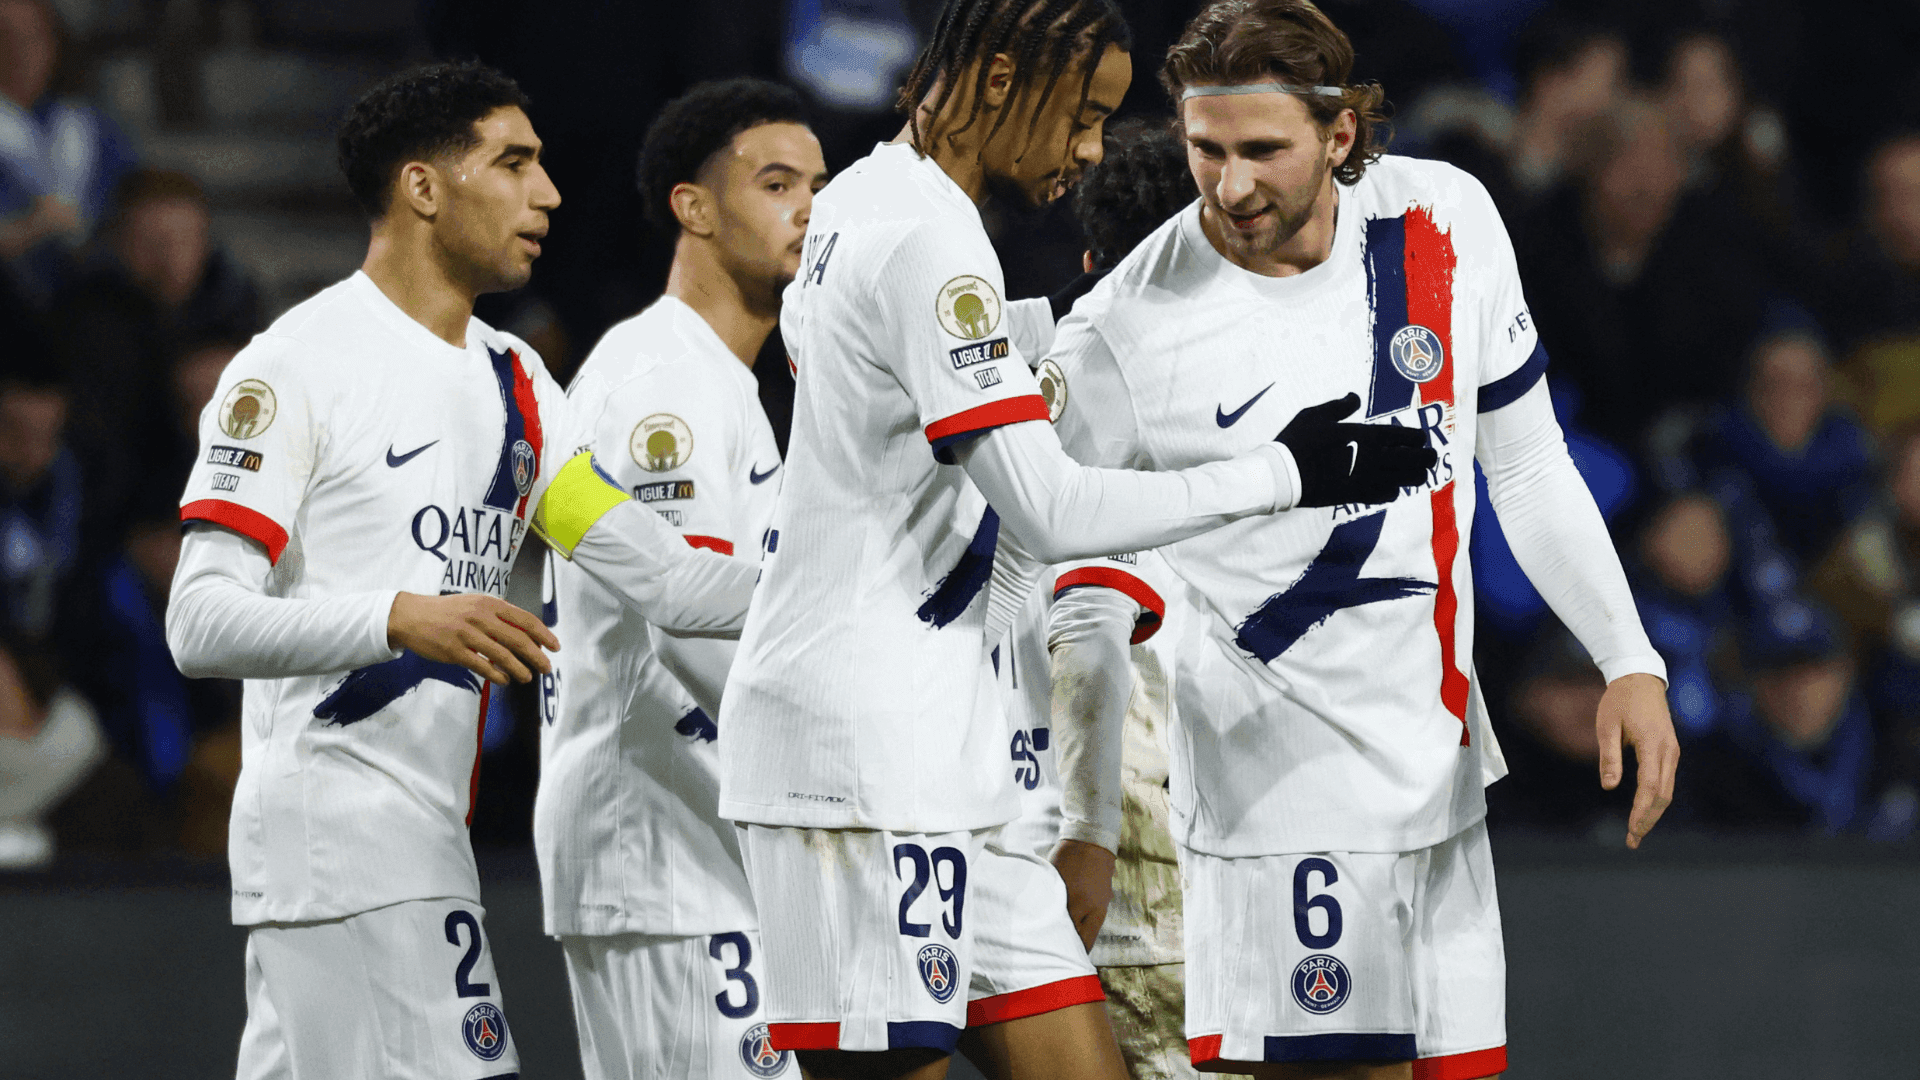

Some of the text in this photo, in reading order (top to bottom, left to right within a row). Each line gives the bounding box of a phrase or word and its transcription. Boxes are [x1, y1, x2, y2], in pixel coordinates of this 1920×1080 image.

[1395, 328, 1428, 347] PARIS
[952, 346, 984, 369] LIGUE
[207, 448, 235, 464] LIGUE
[635, 485, 666, 501] LIGUE
[893, 843, 968, 940] 29
[1292, 857, 1344, 951] 6
[444, 909, 492, 999] 2
[920, 948, 950, 963] PARIS
[1300, 958, 1339, 974] PARIS
[468, 1007, 495, 1024] PARIS
[746, 1026, 769, 1042] PAR
